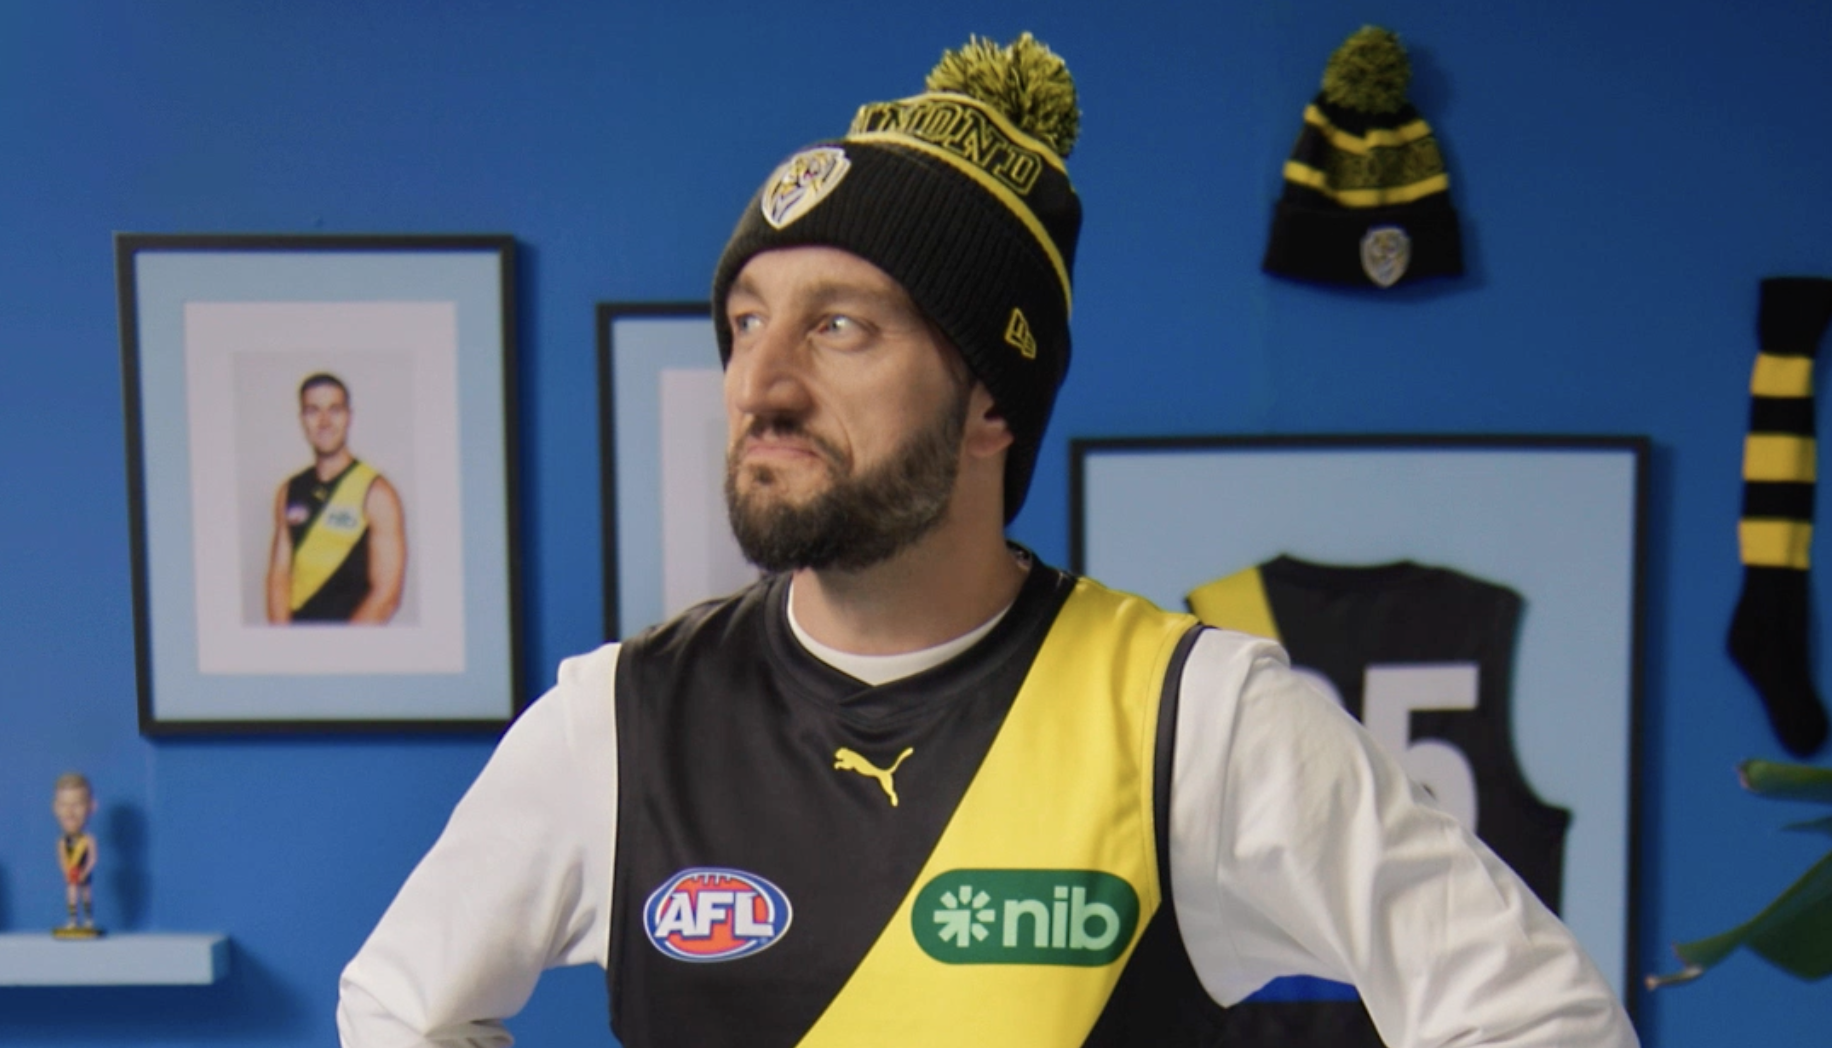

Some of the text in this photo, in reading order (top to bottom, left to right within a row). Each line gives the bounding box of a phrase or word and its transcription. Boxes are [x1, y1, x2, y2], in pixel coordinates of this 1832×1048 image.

[852, 102, 1042, 195] MOND
[1290, 663, 1479, 833] 5
[654, 890, 775, 938] AFL
[1002, 885, 1120, 951] nib
